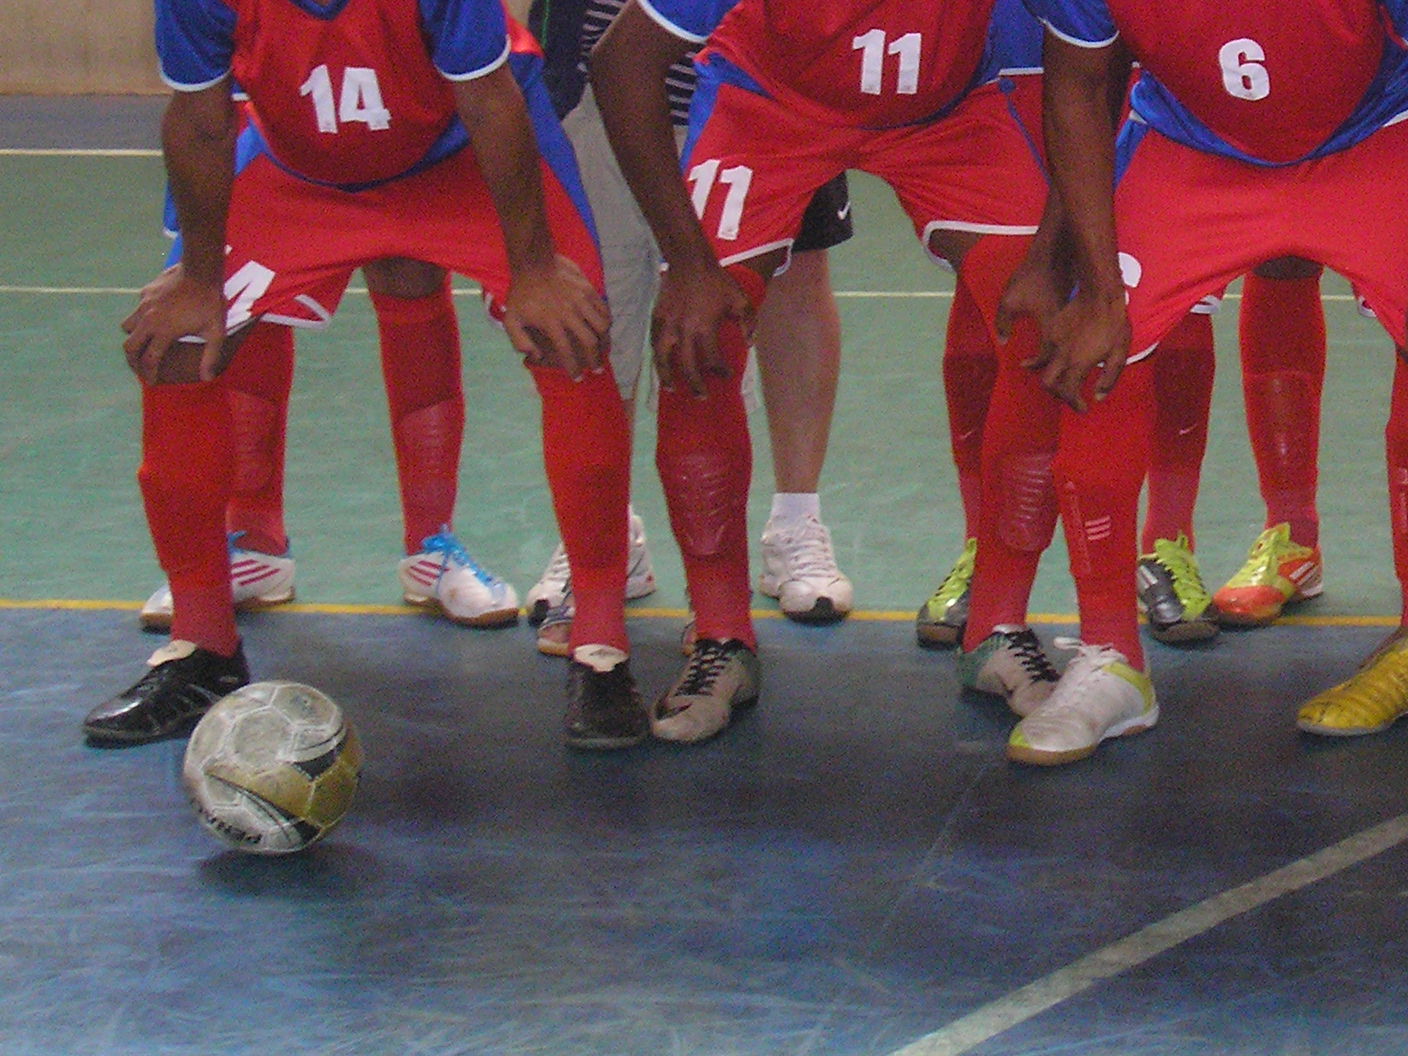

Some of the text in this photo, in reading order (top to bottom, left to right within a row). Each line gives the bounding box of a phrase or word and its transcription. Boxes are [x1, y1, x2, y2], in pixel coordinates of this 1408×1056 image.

[852, 29, 922, 95] 11
[1218, 38, 1270, 101] 6
[300, 64, 391, 134] 14
[688, 159, 753, 241] 11
